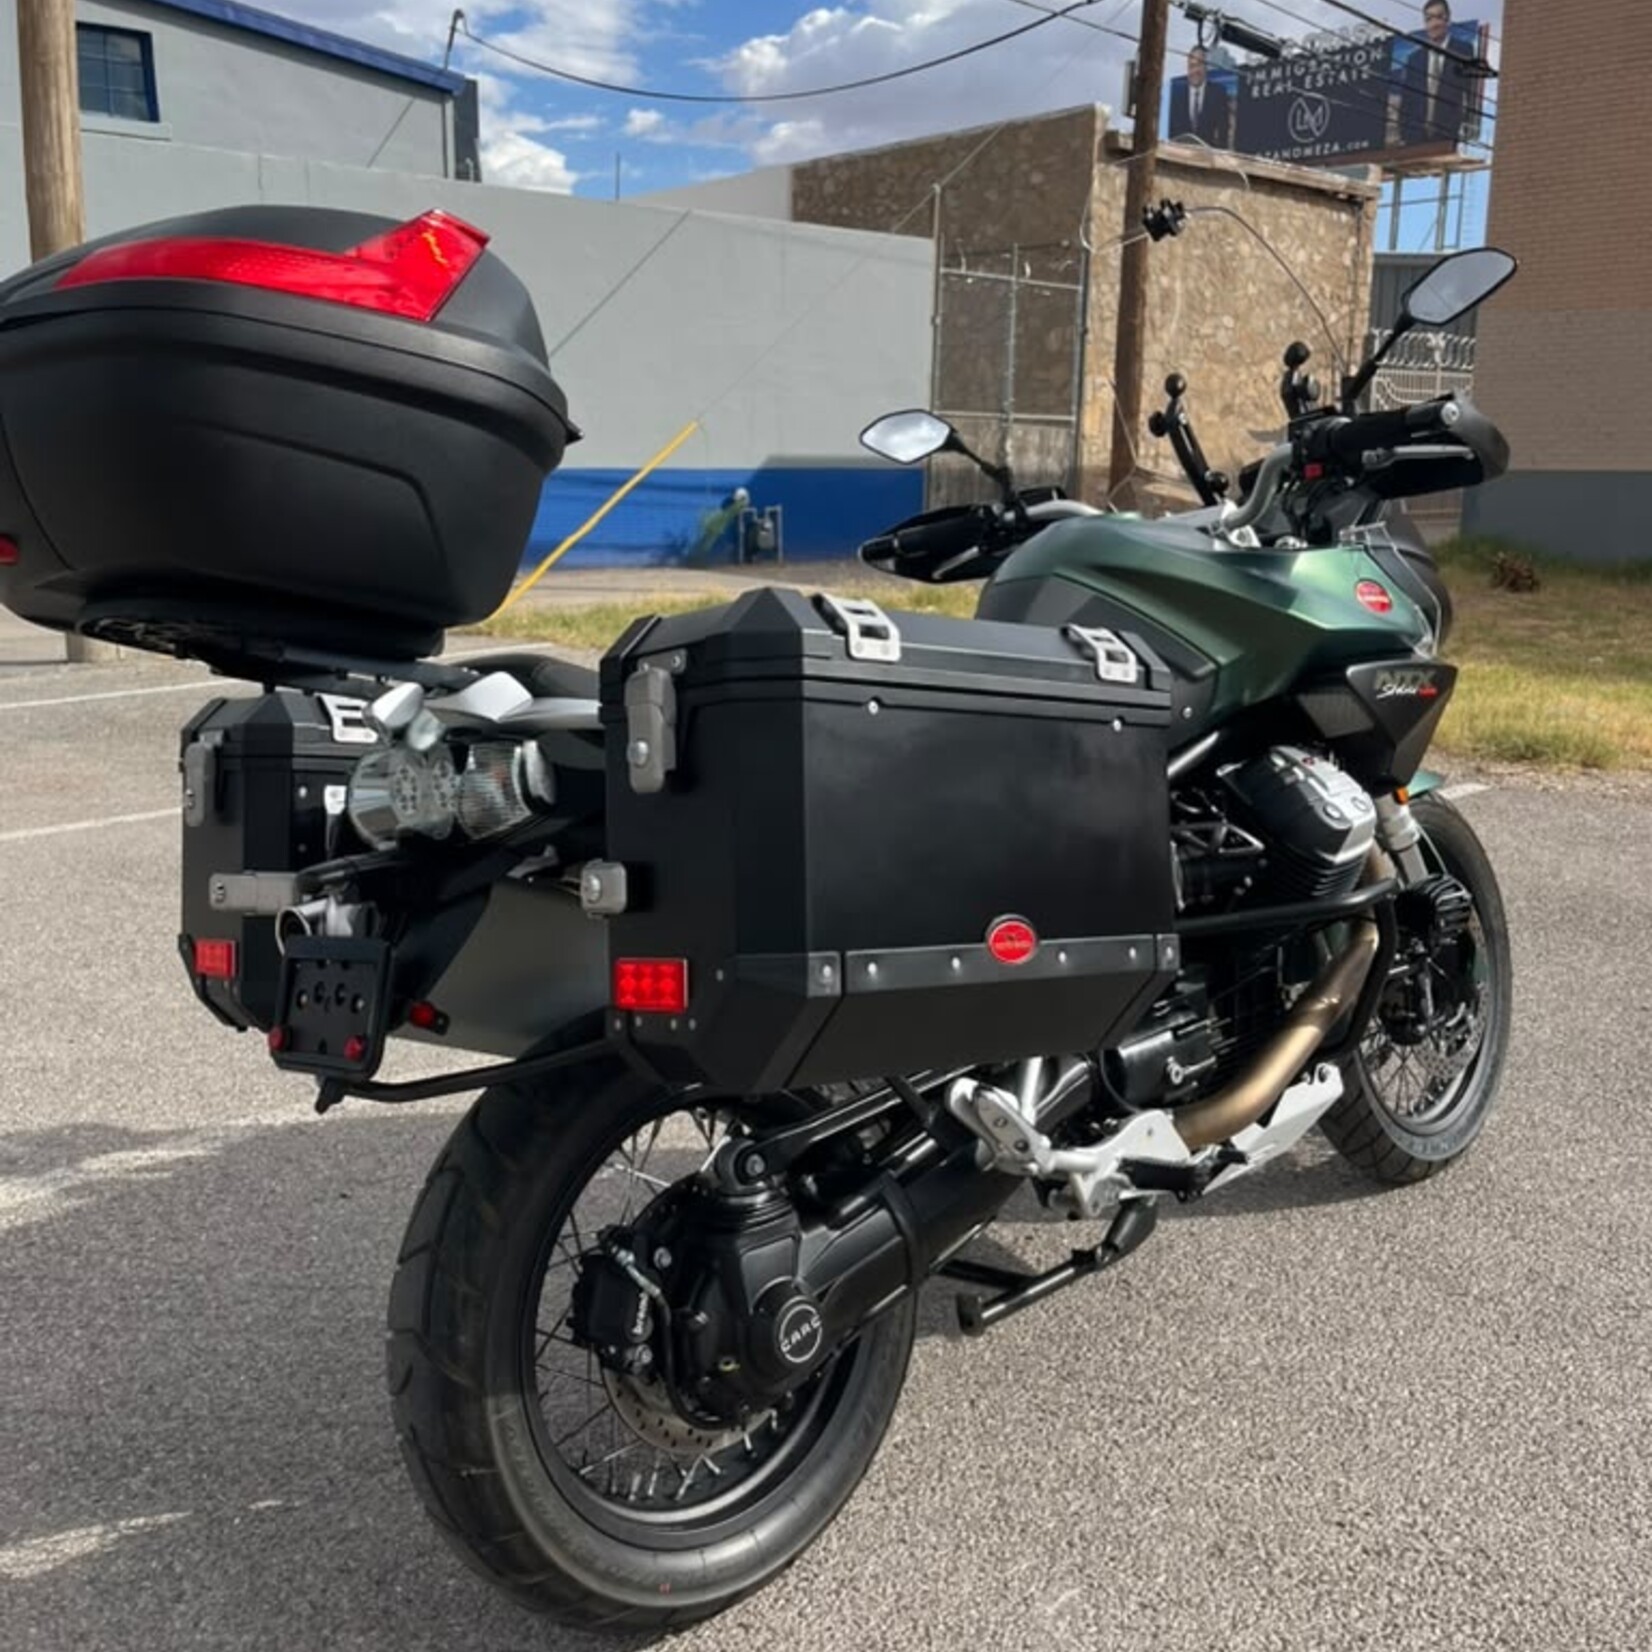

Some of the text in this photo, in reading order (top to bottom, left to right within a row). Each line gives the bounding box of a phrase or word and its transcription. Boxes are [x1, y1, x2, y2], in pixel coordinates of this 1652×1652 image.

[1252, 64, 1371, 98] REAL ESTATE
[780, 1314, 822, 1353] CARC
